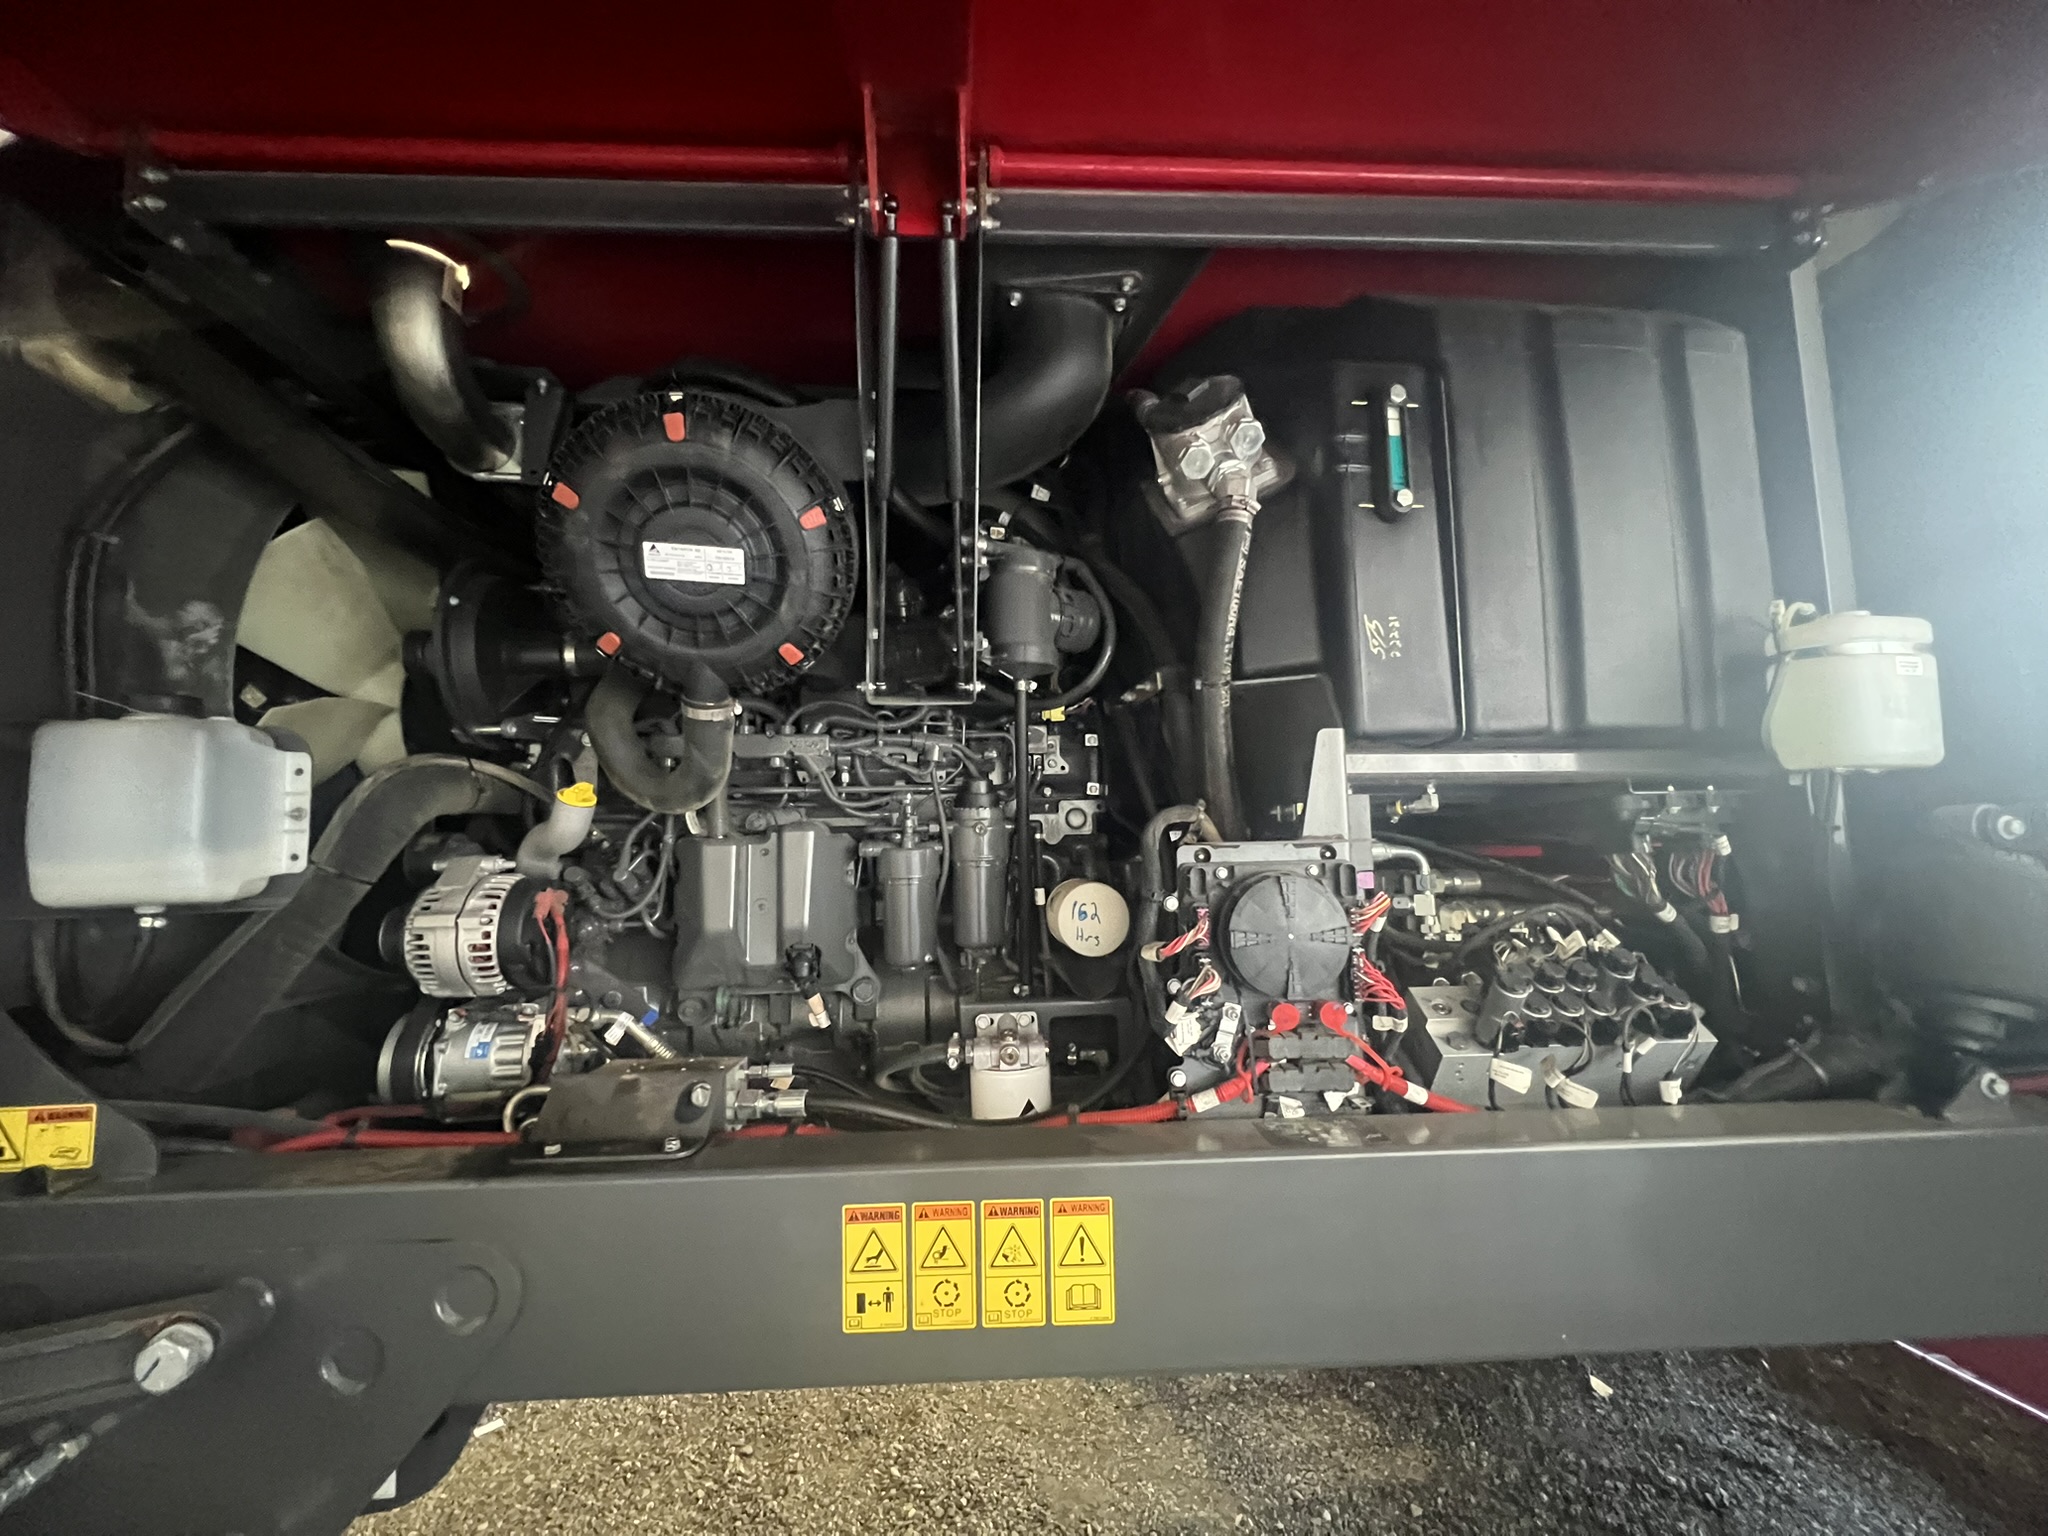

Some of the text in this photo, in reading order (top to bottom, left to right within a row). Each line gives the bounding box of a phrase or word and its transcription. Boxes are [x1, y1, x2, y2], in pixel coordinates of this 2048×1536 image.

[1071, 900, 1101, 925] 162
[1076, 926, 1100, 947] Hrs
[932, 1206, 968, 1217] WARNING
[999, 1205, 1039, 1217] WARNING
[1071, 1203, 1106, 1213] WARNING
[860, 1210, 900, 1221] WARNING
[932, 1308, 962, 1319] STOP
[1004, 1308, 1033, 1319] STOP
